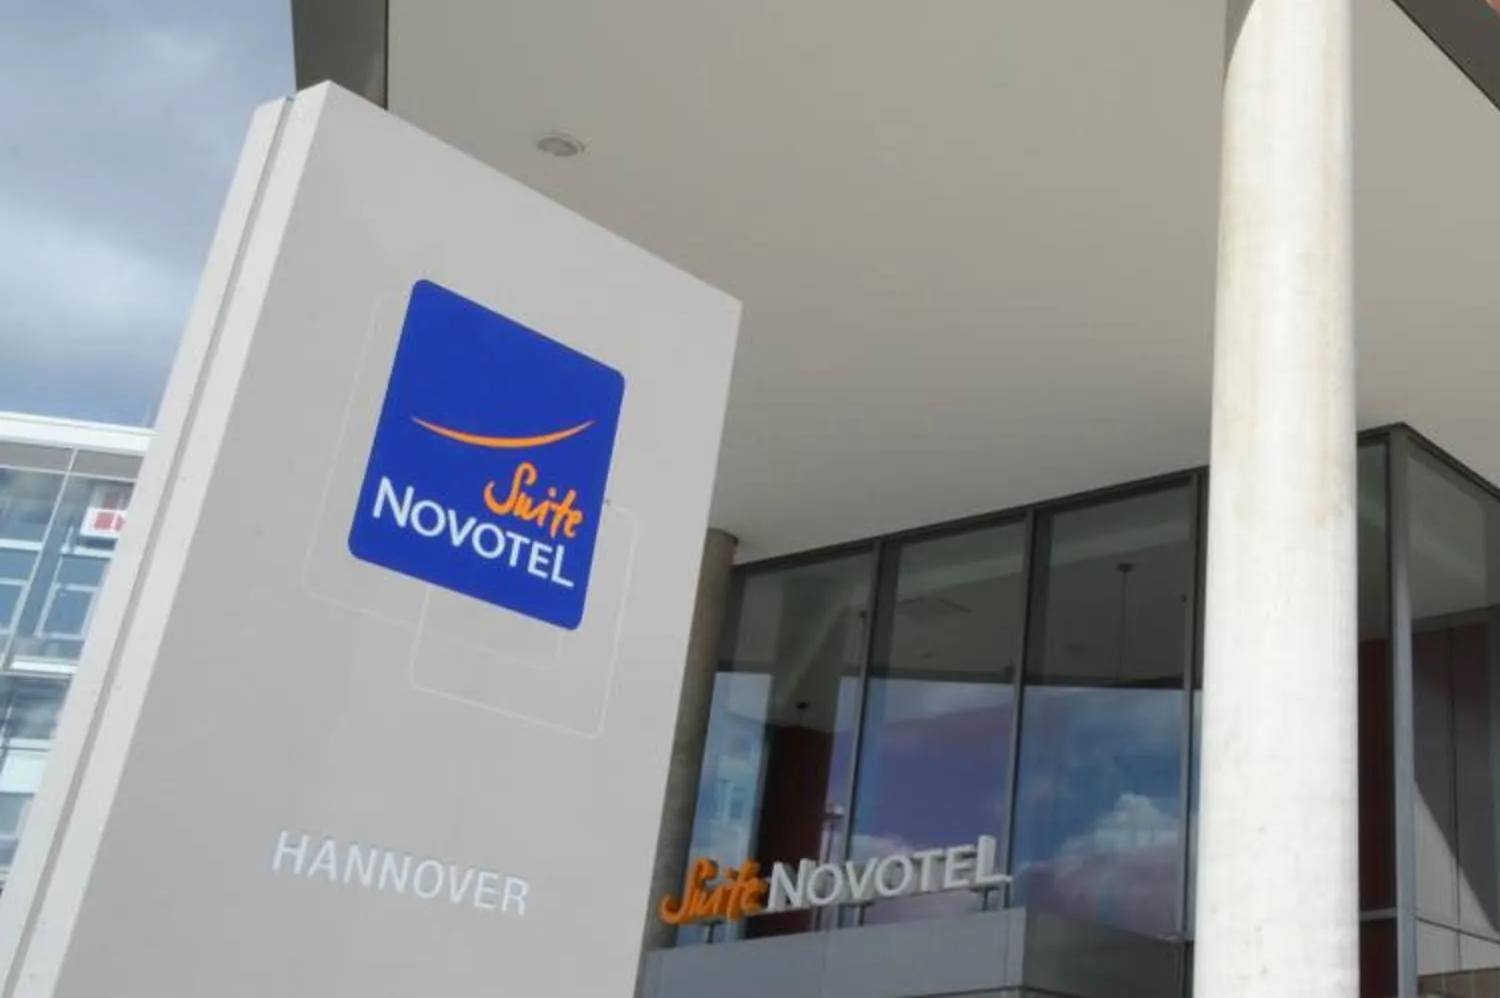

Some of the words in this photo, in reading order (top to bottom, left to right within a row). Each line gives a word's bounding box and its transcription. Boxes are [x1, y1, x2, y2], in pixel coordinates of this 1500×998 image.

[372, 475, 574, 587] NOVOTEL
[483, 461, 583, 538] Suite
[271, 830, 530, 916] HANNOVER
[659, 857, 769, 924] Suite
[767, 835, 1013, 912] NOVOTEL
